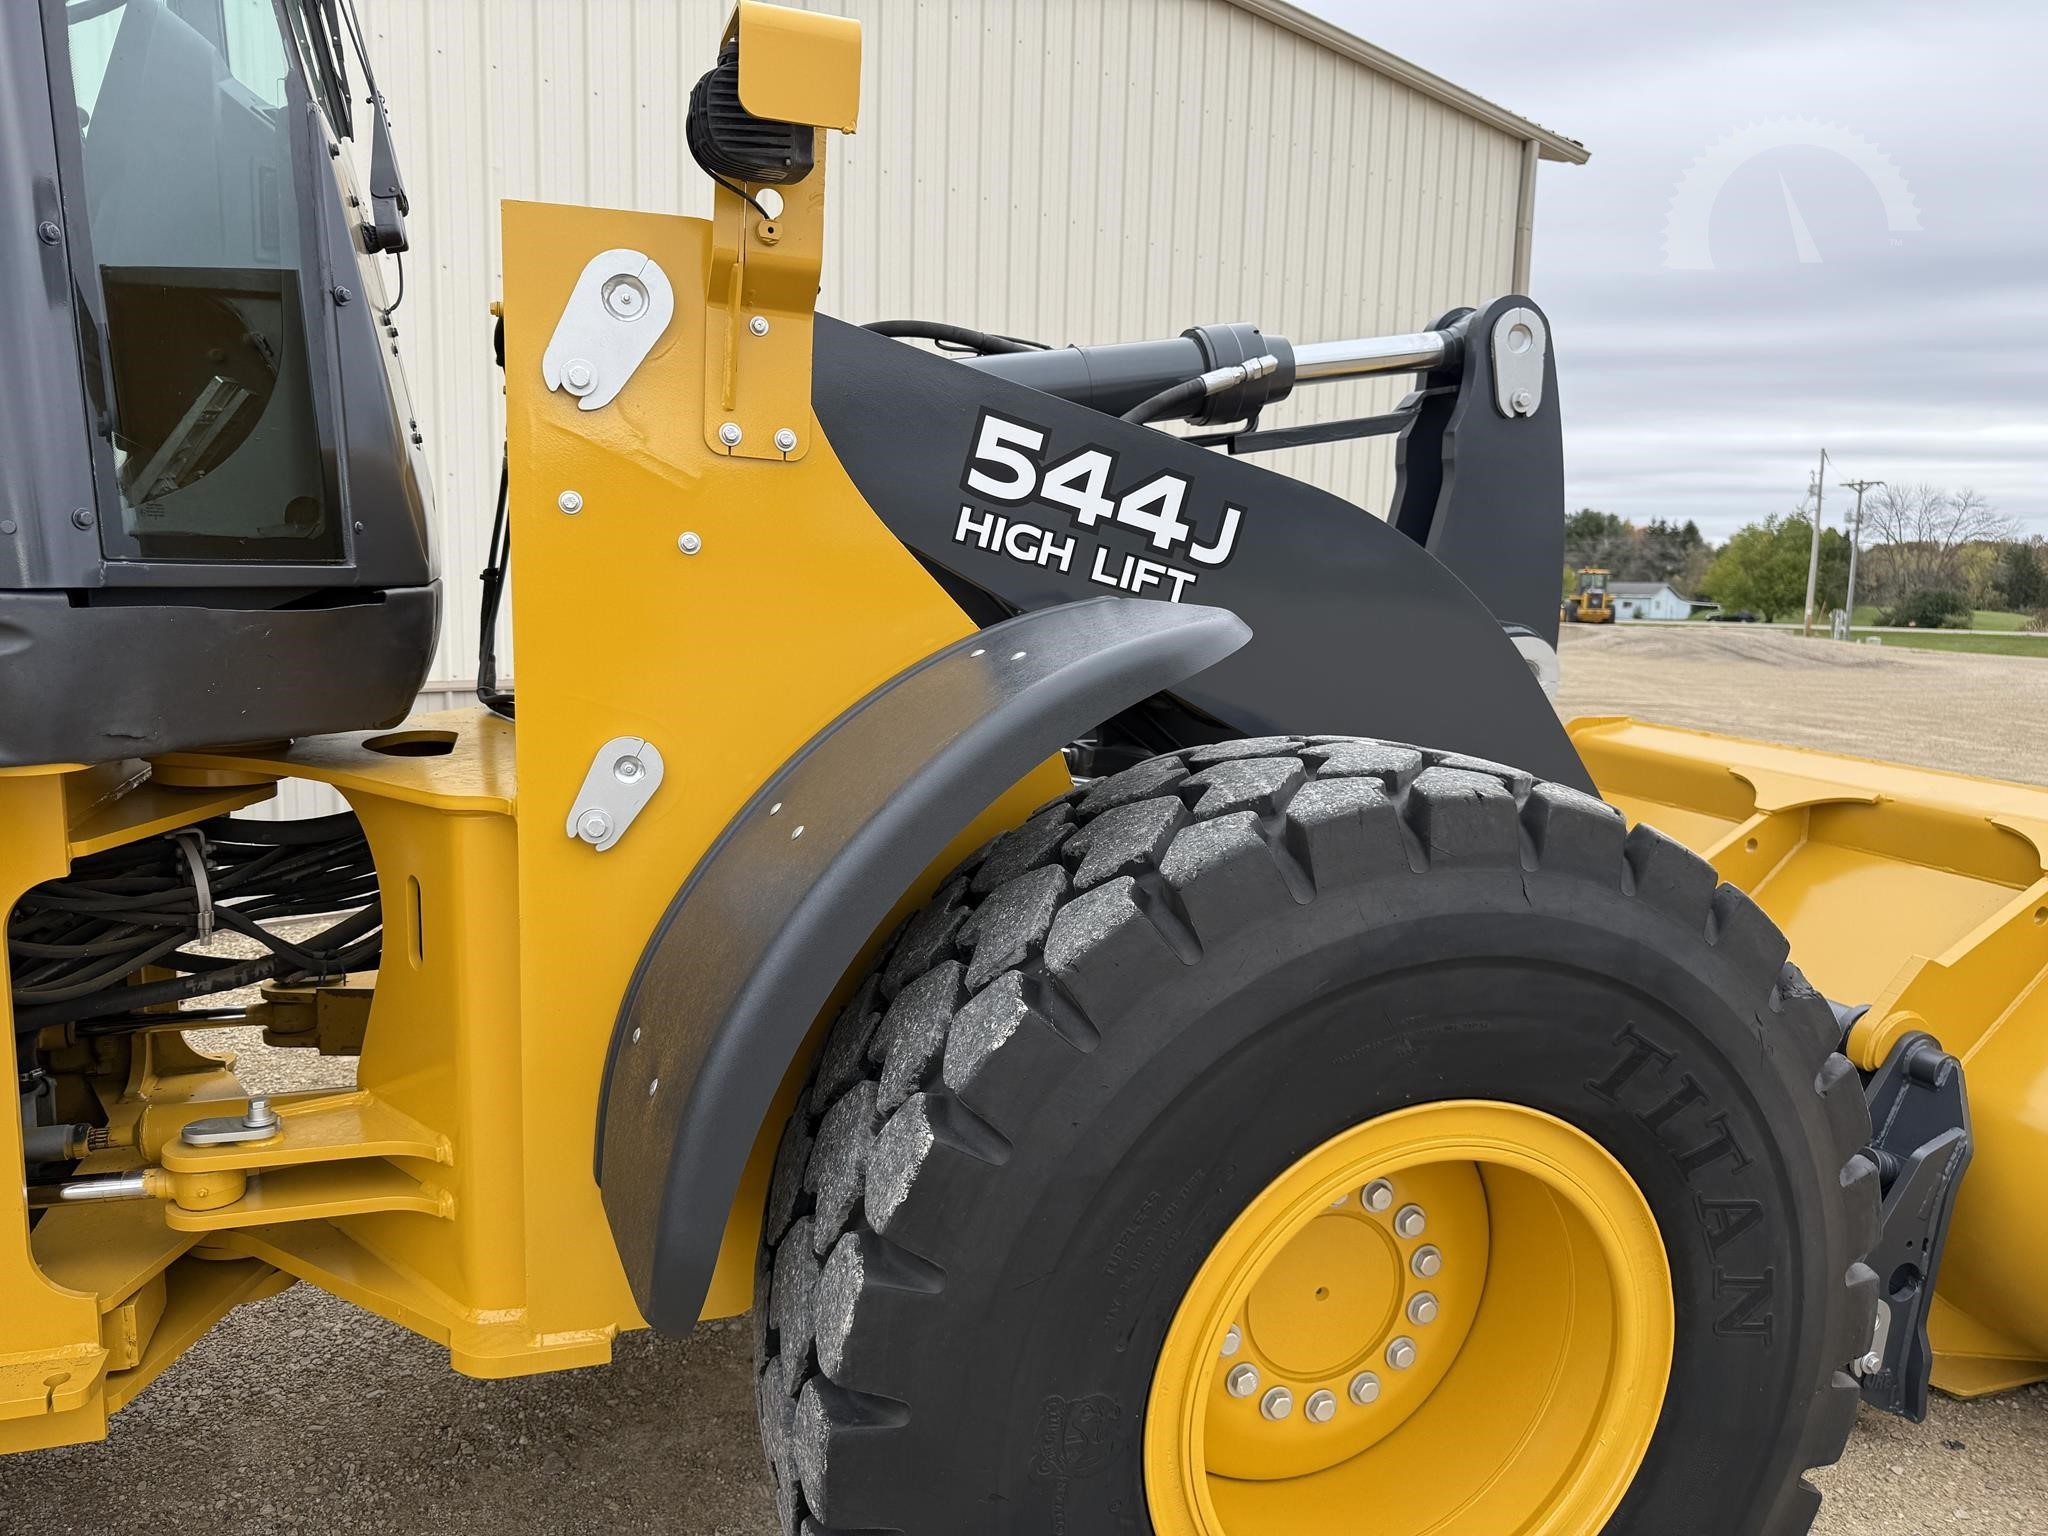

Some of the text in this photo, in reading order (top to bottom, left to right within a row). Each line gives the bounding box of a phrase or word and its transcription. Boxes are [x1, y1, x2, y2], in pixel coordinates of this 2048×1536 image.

[955, 506, 1196, 603] HIGH LIFT
[967, 414, 1241, 565] 544J
[1583, 1020, 1776, 1345] TITAN
